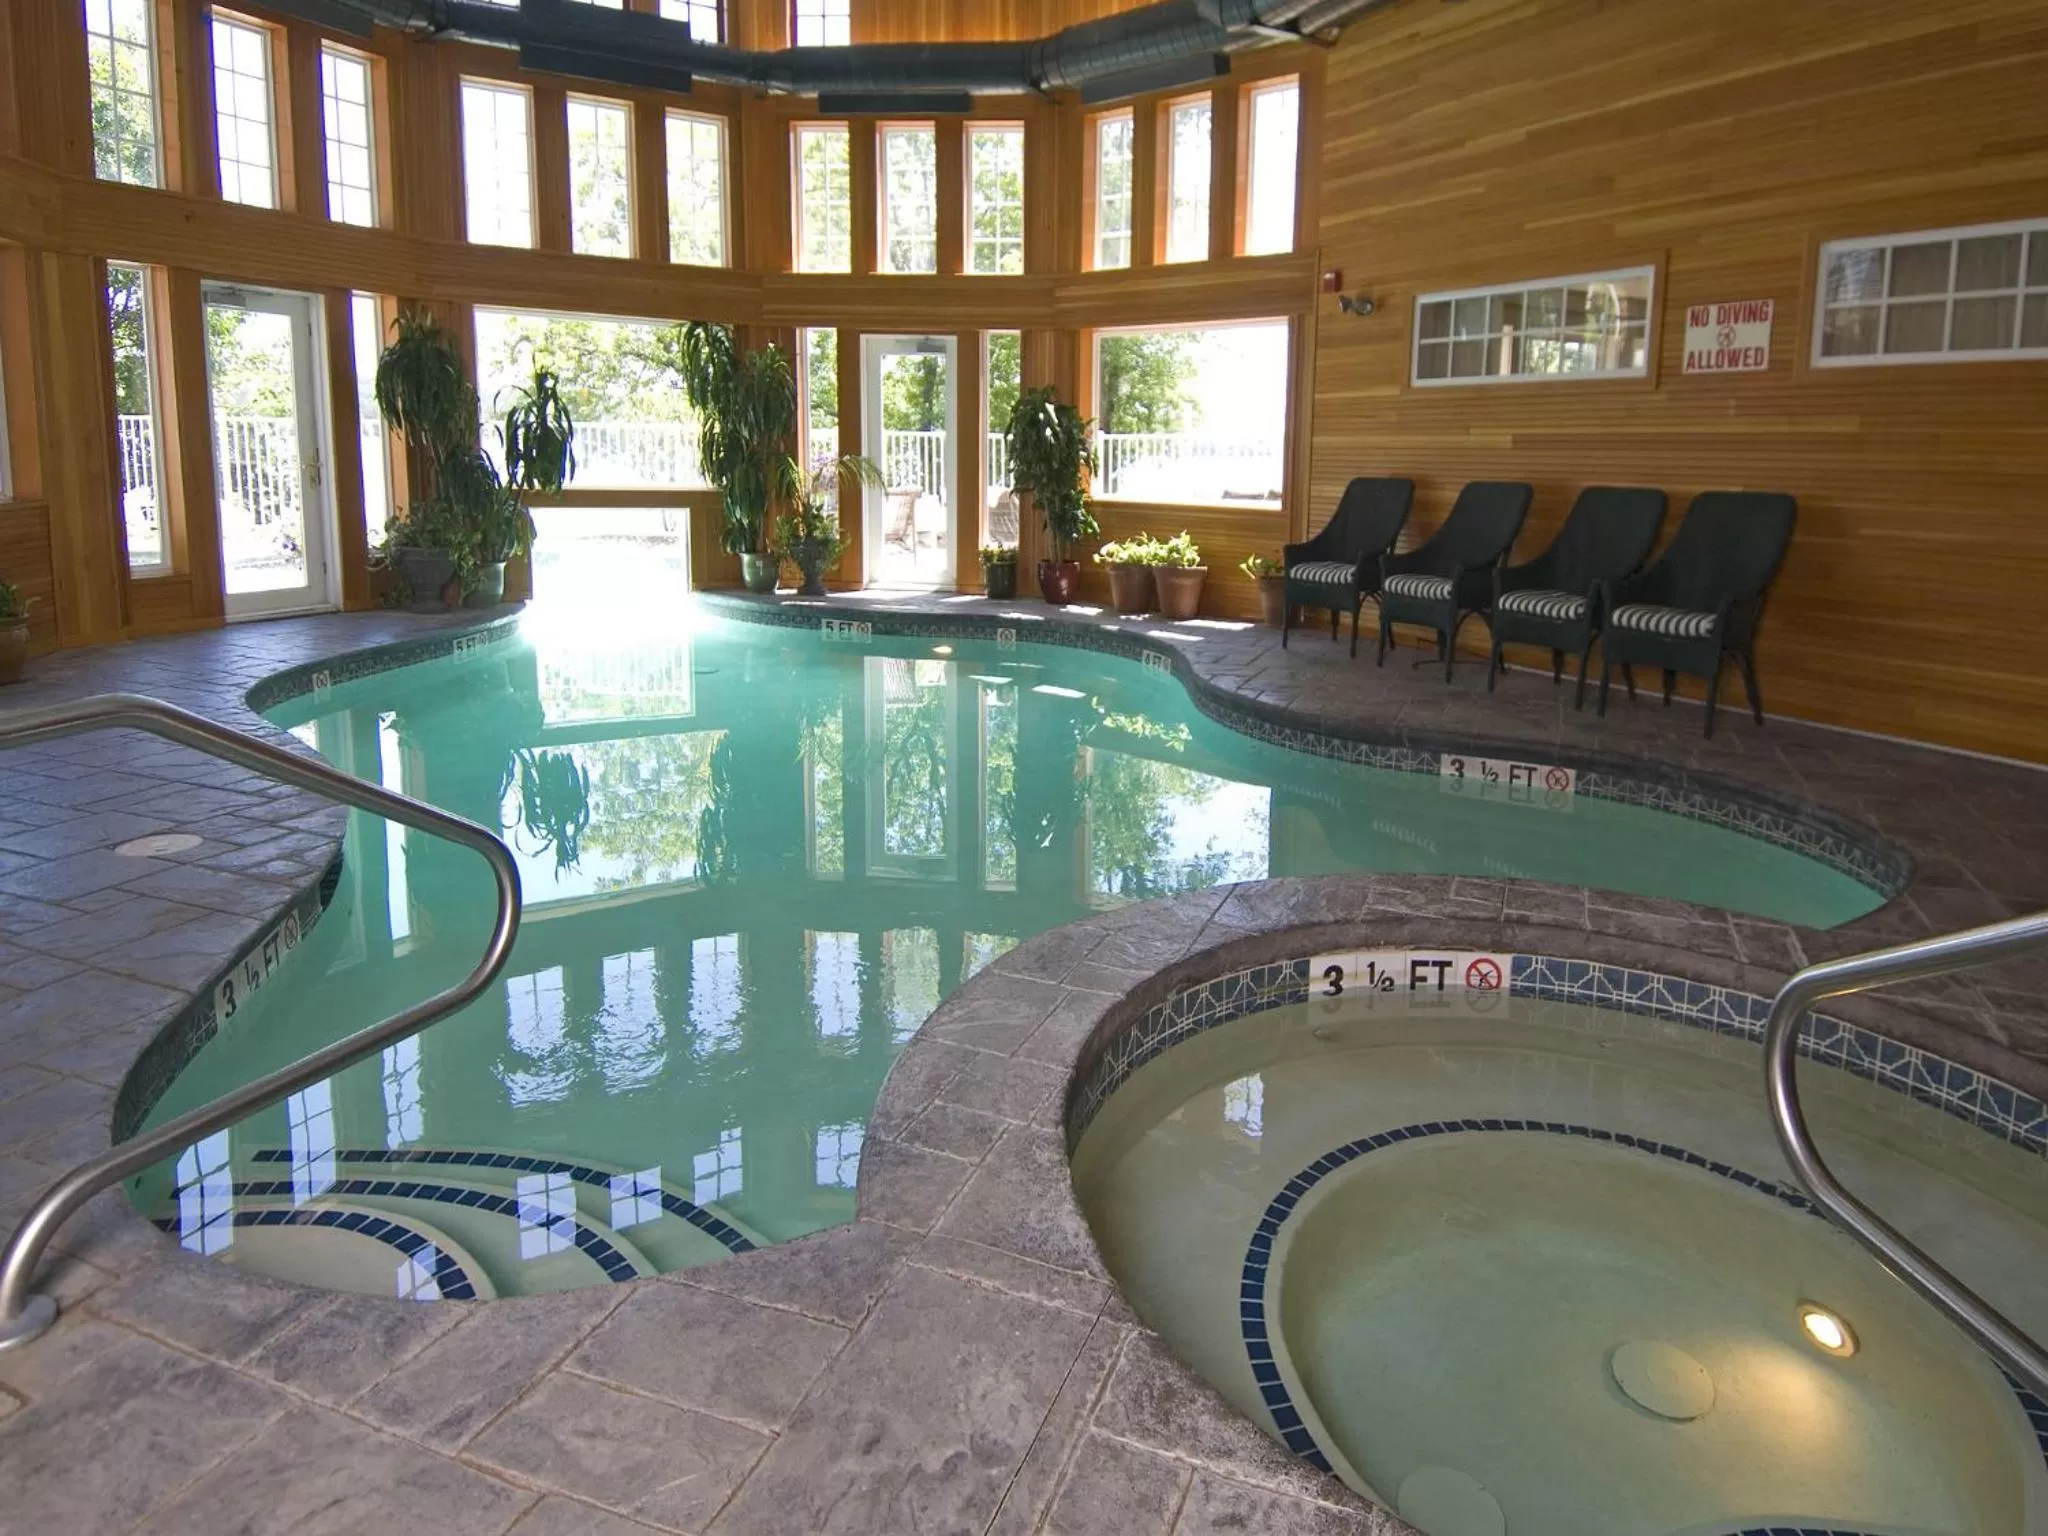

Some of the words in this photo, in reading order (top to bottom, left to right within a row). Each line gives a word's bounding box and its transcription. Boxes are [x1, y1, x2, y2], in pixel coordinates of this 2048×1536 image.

[1690, 307, 1709, 328] NO
[1716, 301, 1769, 325] DIVING
[1686, 346, 1764, 370] ALLOWED
[839, 623, 853, 633] FT
[1450, 758, 1465, 778] 3
[1509, 764, 1537, 787] FT
[223, 980, 236, 1019] 3
[263, 929, 279, 978] FT
[1323, 965, 1344, 996] 3
[1410, 959, 1453, 991] FT
